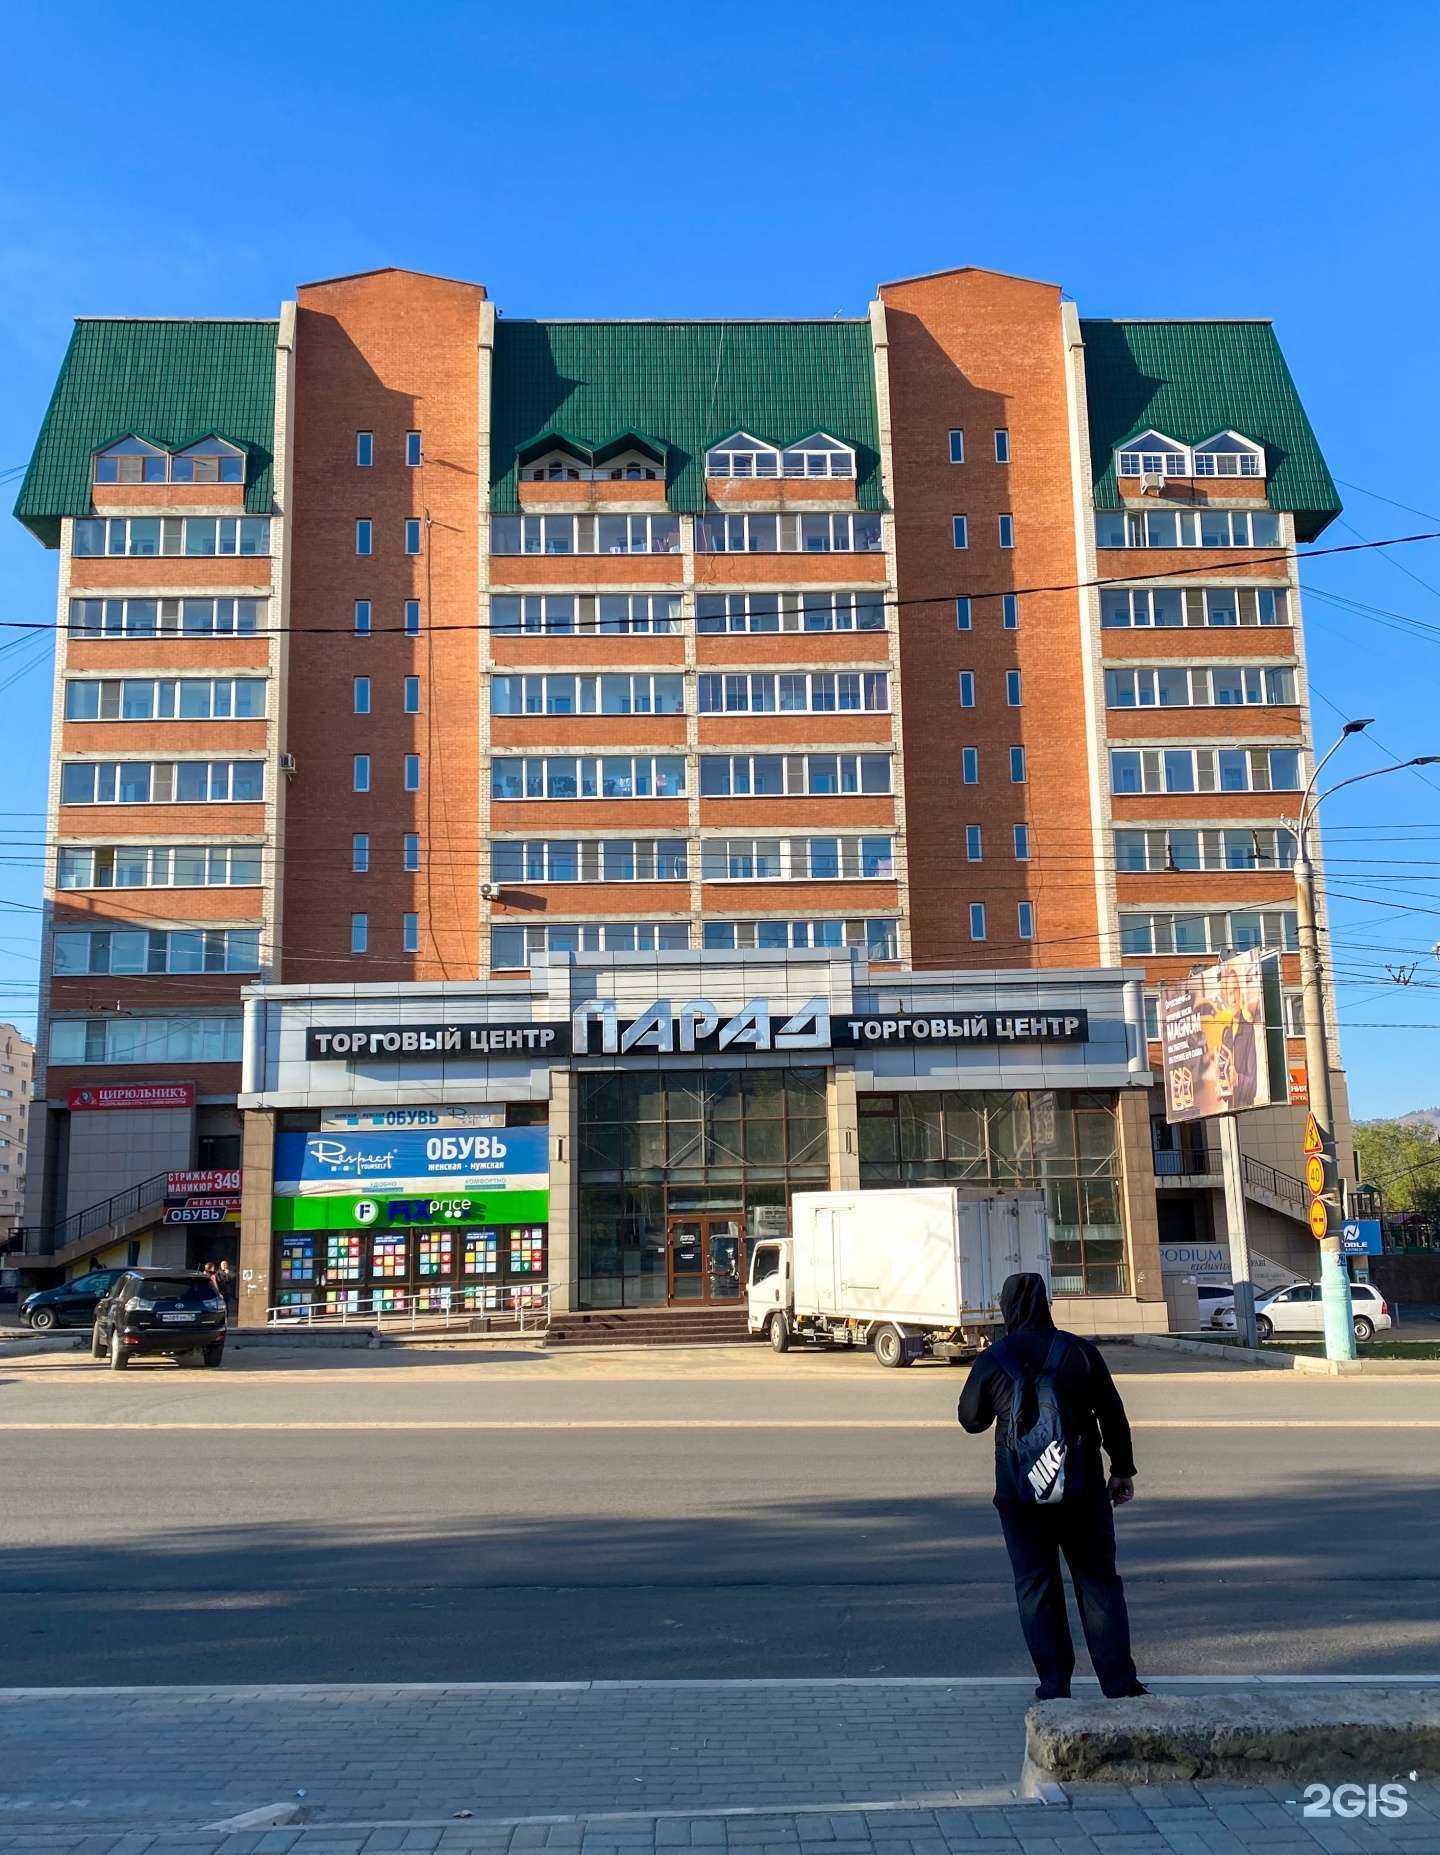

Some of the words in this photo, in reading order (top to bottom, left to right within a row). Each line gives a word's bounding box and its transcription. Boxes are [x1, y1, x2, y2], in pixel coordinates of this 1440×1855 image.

[572, 996, 830, 1055] ПАРАД
[848, 1014, 988, 1040] ТОРГОВЫЙ
[996, 1017, 1080, 1040] ЦЕНТР
[1166, 1012, 1202, 1041] MAGNUM
[315, 1026, 461, 1055] ТОРГОВЫЙ
[469, 1029, 556, 1053] ЦЕНТР
[99, 1087, 187, 1100] ЦИРЮЛЬНИКЪ
[386, 1110, 440, 1126] ОБУВЬ
[307, 1140, 395, 1175] Respect
[426, 1135, 508, 1161] ОБУВЬ
[168, 1171, 213, 1182] СТРИЖКА
[1310, 1166, 1321, 1184] 40
[168, 1182, 213, 1193] МАНИКЮР
[171, 1209, 220, 1222] ОБУВЬ
[359, 1204, 371, 1219] F
[429, 1199, 472, 1214] price
[1027, 1440, 1065, 1498] NIKE
